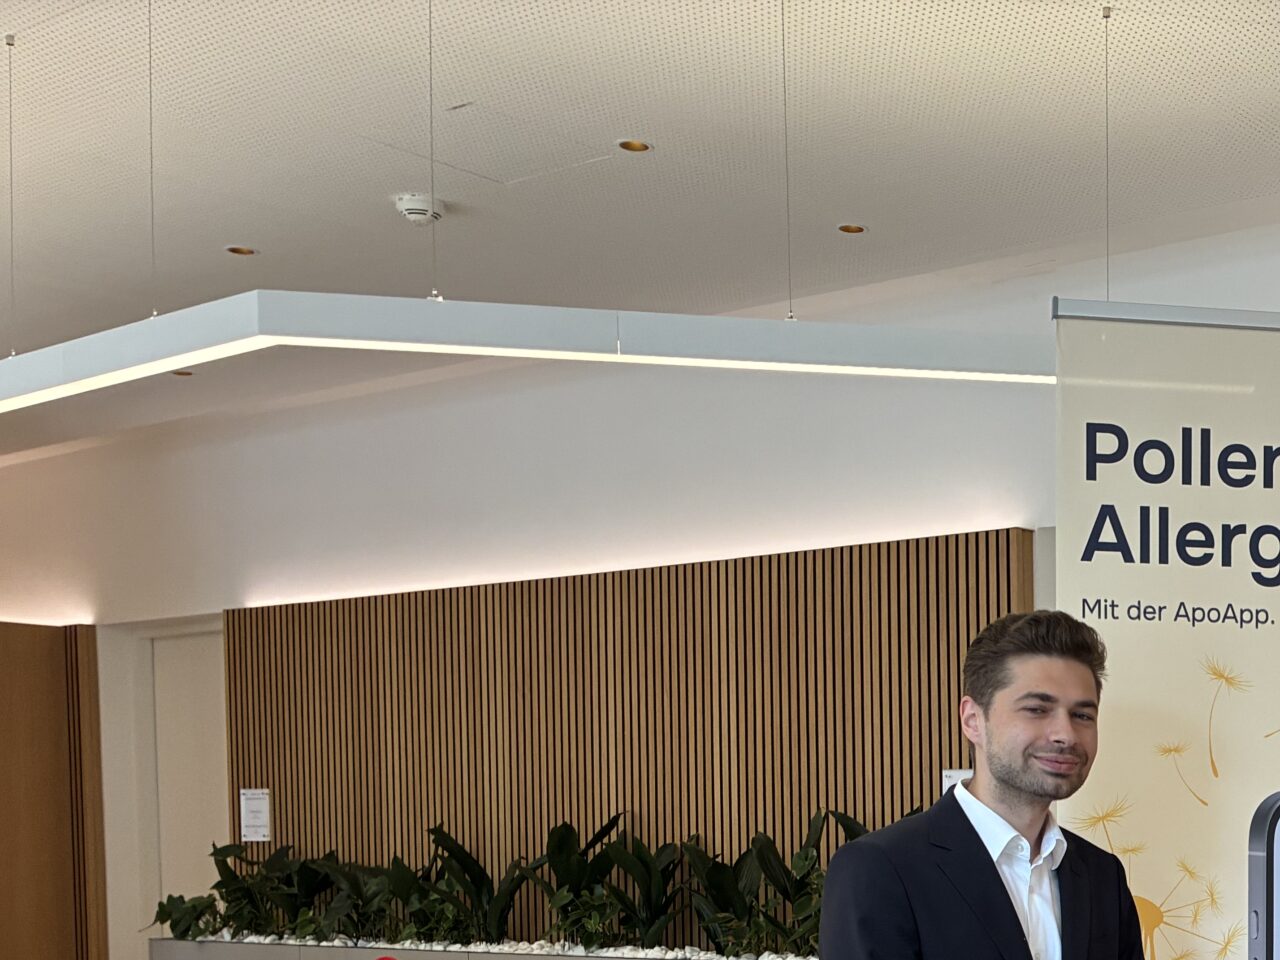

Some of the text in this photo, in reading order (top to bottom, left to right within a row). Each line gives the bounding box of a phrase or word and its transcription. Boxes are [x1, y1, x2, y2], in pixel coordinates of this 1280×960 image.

[1081, 598, 1276, 628] Mit der ApoApp.
